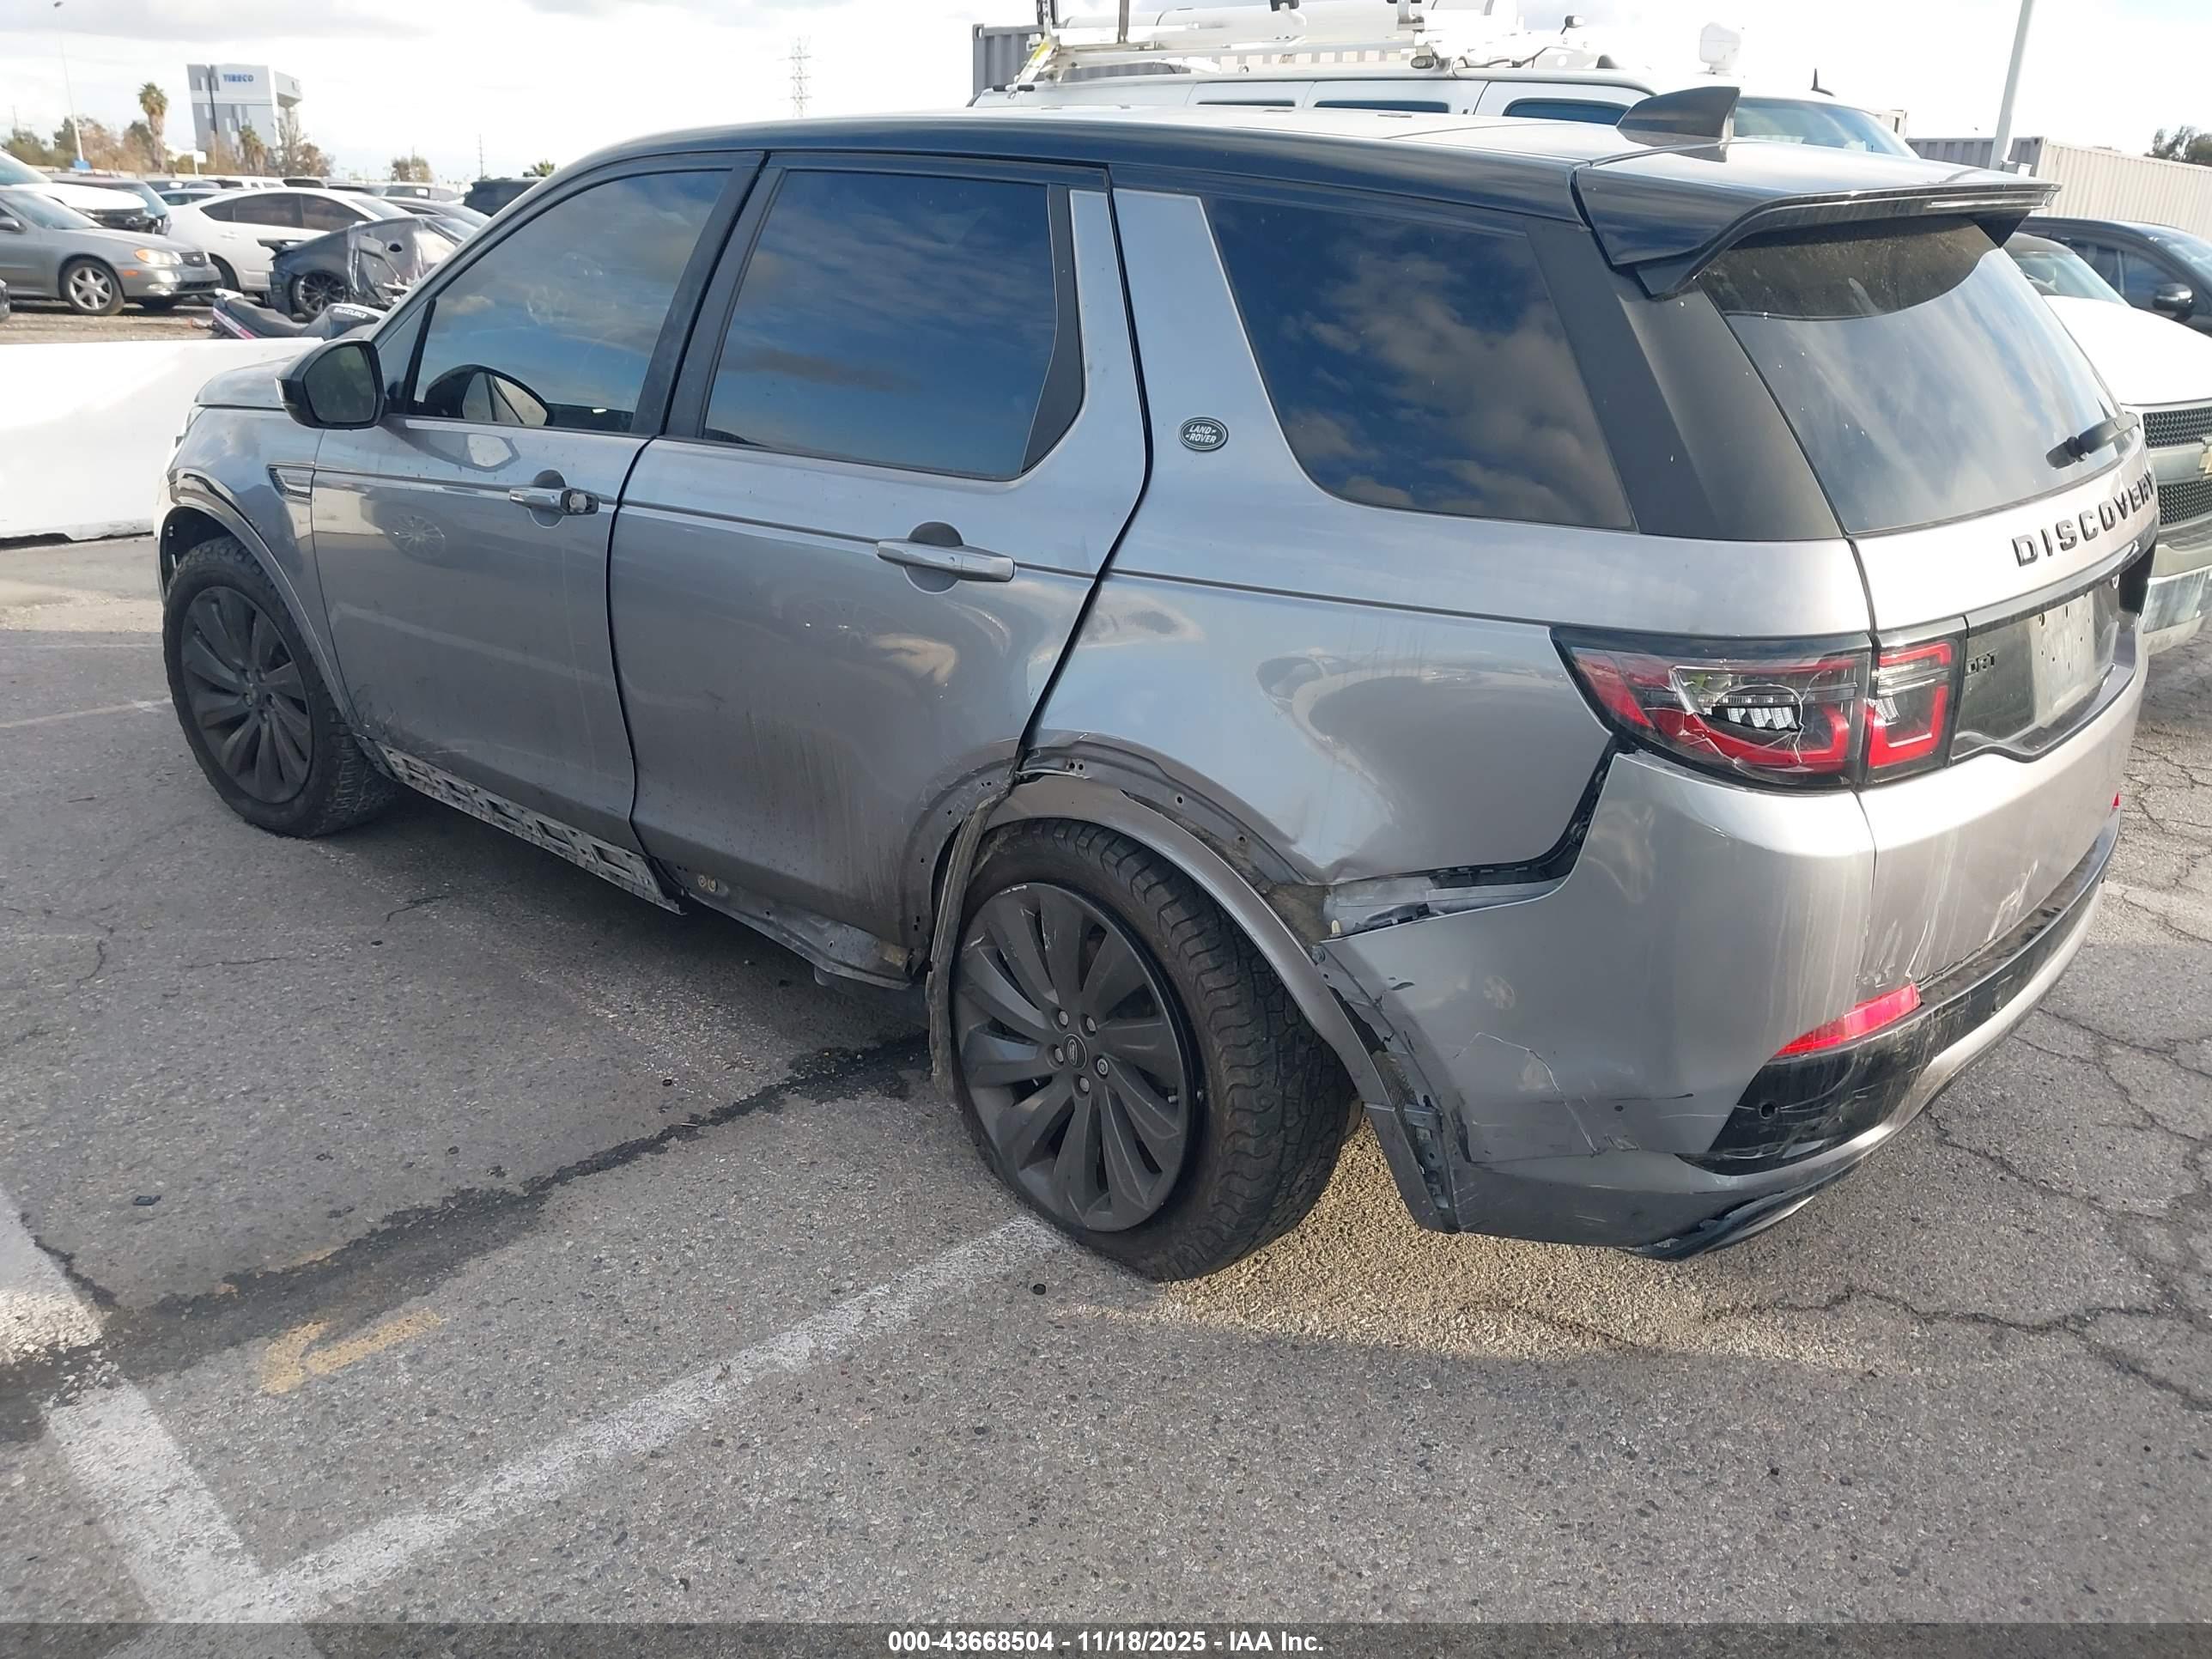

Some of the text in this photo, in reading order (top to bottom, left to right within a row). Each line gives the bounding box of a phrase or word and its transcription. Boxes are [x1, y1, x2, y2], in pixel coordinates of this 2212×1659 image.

[333, 307, 368, 319] SUZUKI
[1189, 433, 1217, 444] ROVER
[2011, 469, 2154, 568] DISCOVERY
